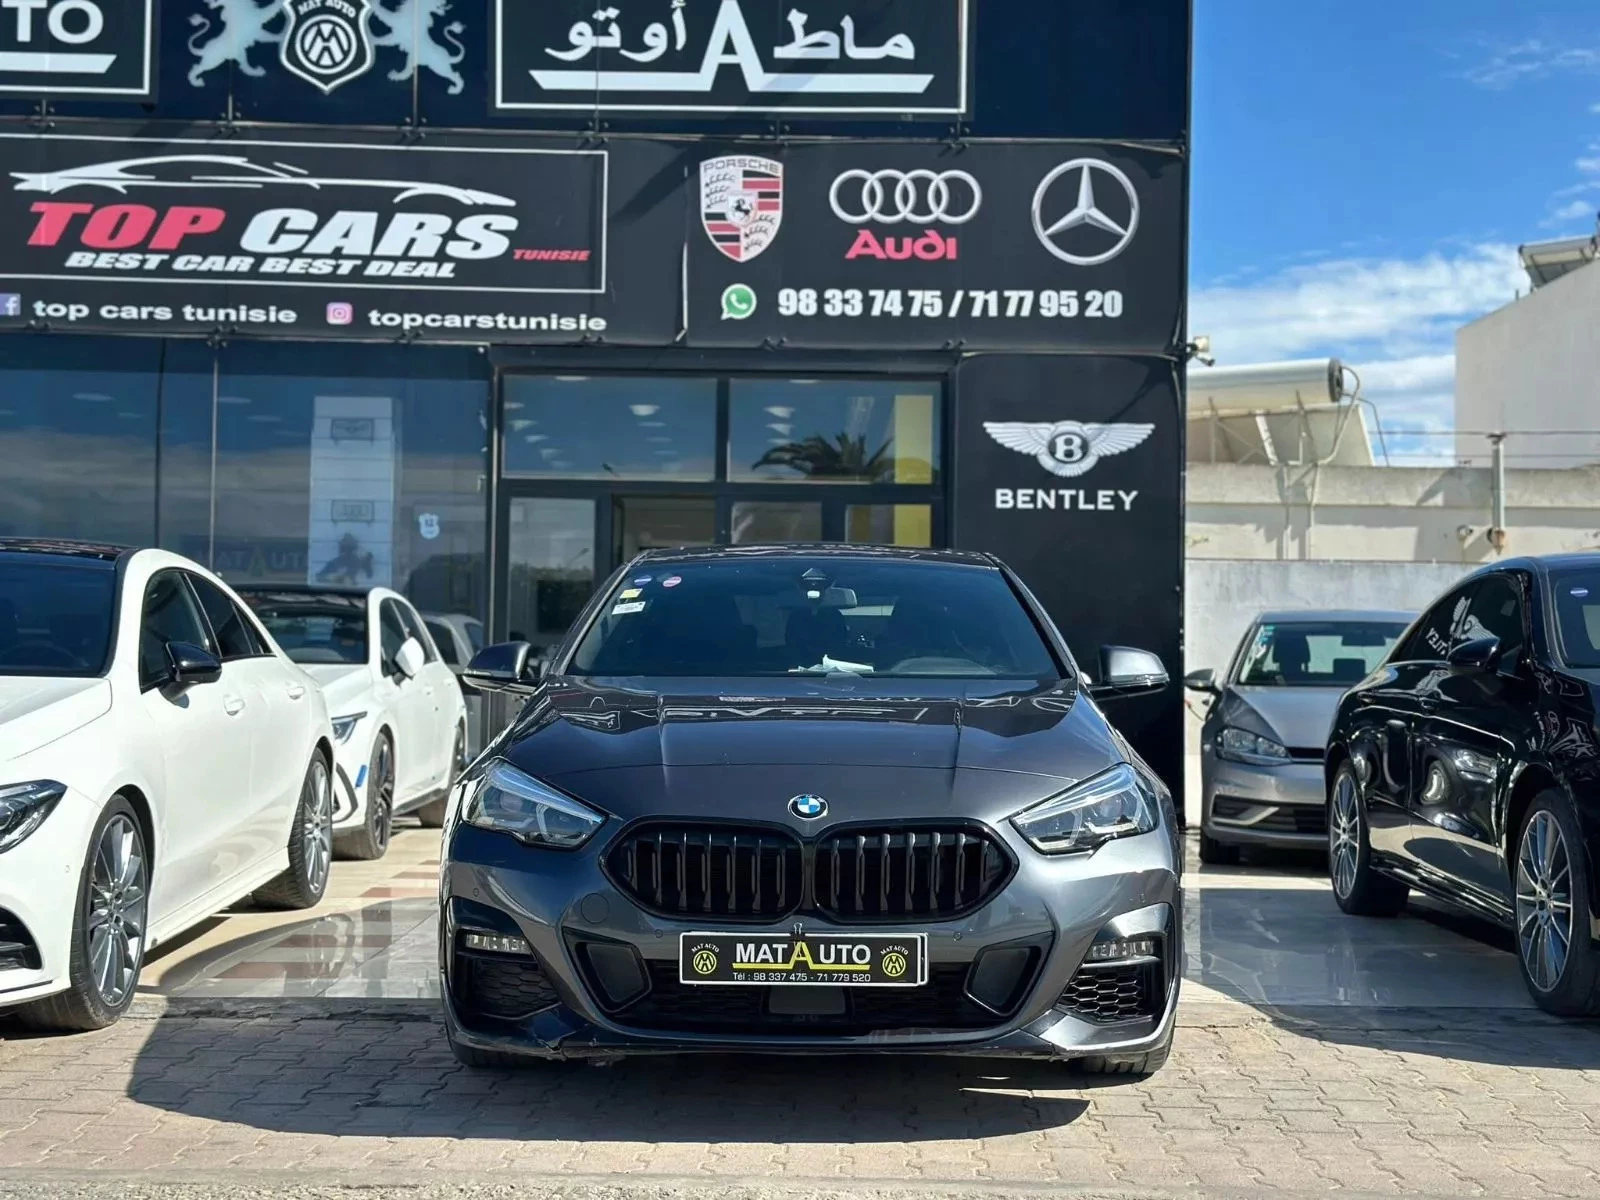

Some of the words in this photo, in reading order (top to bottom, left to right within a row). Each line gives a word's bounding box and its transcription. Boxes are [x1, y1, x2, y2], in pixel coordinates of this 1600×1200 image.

[545, 0, 687, 63] أوتو
[774, 8, 915, 60] ماط
[703, 158, 780, 174] PORSCHE
[27, 202, 227, 250] TOP
[240, 208, 519, 260] CARS
[512, 248, 591, 262] TUNISIE
[845, 229, 957, 260] Audi
[64, 251, 169, 270] BEST
[172, 254, 255, 273] CAR
[259, 257, 362, 275] BEST
[363, 260, 455, 278] DEAL
[33, 301, 90, 320] top
[100, 303, 173, 320] cars
[182, 305, 298, 323] tunisie
[778, 288, 816, 316] 98
[824, 289, 862, 316] 33
[868, 289, 903, 316] 74
[908, 290, 943, 317] 75
[969, 290, 998, 317] 71
[1003, 290, 1034, 317] 77
[1039, 290, 1078, 317] 95
[1084, 290, 1123, 318] 20
[368, 309, 607, 331] topcarstunisie
[995, 488, 1138, 511] BENTLEY
[736, 943, 788, 963] MAT
[790, 942, 871, 967] AUTO
[733, 972, 746, 981] Tél
[753, 972, 766, 981] 98
[768, 972, 787, 981] 337
[790, 972, 808, 981] 475
[817, 973, 828, 981] 71
[832, 973, 850, 982] 779
[852, 973, 871, 982] 520
